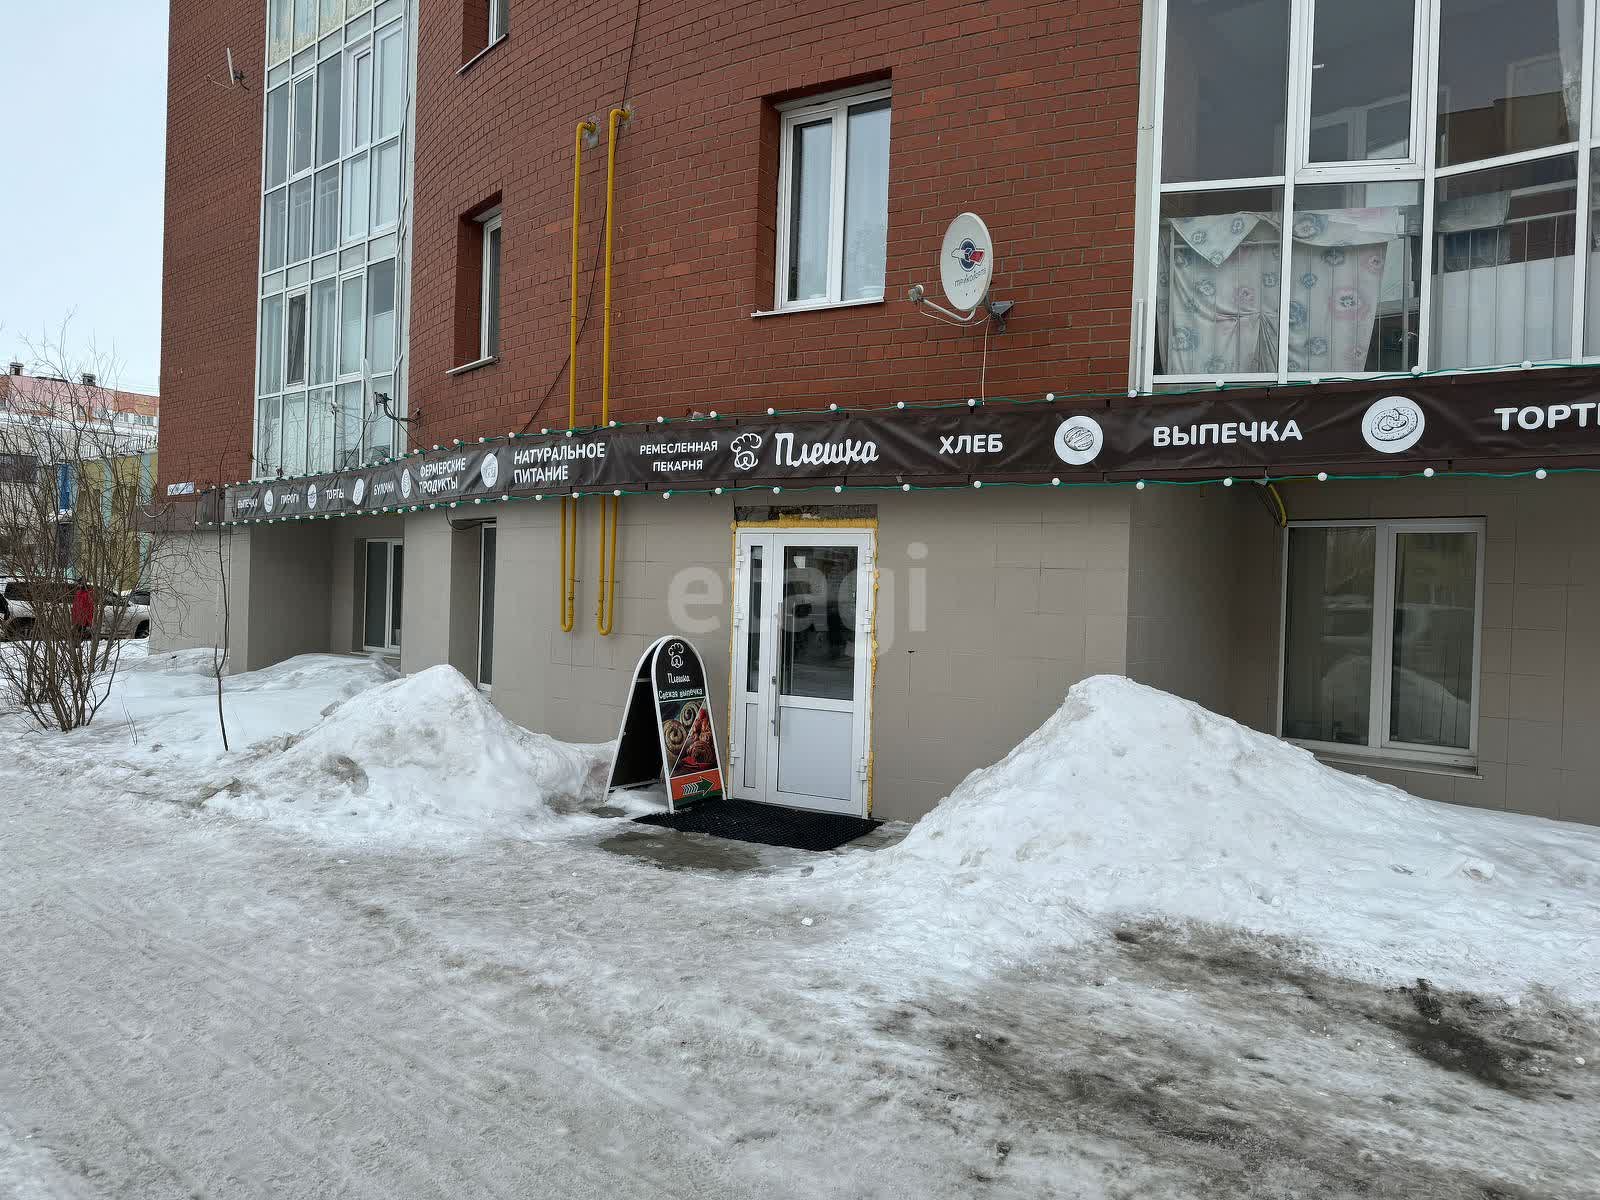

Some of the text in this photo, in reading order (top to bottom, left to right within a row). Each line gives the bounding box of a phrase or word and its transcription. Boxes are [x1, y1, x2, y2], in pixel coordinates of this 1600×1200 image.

[1493, 402, 1600, 431] ТОРТ
[1152, 419, 1303, 447] ВЫПЕЧКА
[513, 442, 606, 465] НАТУРАЛЬНОЕ
[639, 440, 718, 455] РЕМЕСЛЕННАЯ
[774, 432, 880, 468] Плешка
[938, 433, 1004, 455] ХЛЕБ
[420, 457, 467, 478] ФЕРМЕРСКИЕ
[513, 465, 569, 484] ПИТАНИЕ
[652, 459, 703, 472] ПЕКАРНЯ
[325, 488, 345, 500] ТОРТЫ
[418, 475, 458, 495] ПРОДУКТЫ
